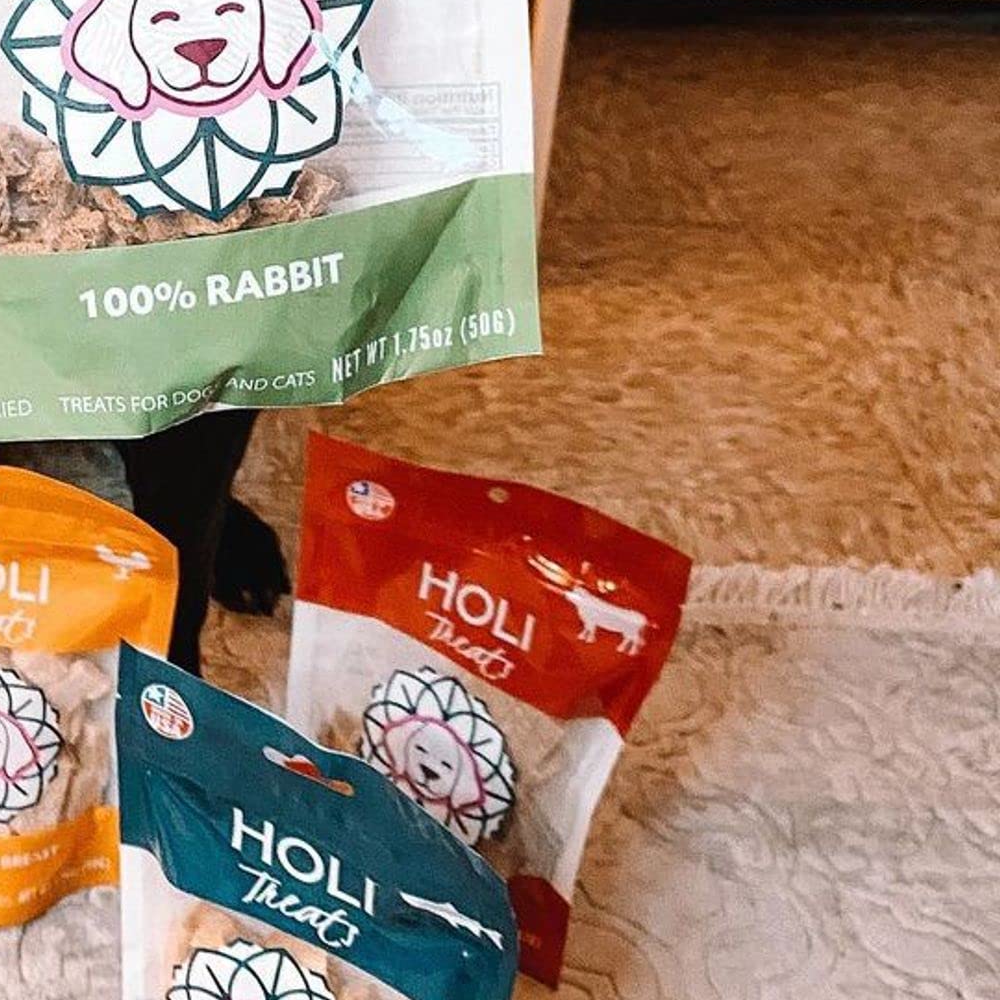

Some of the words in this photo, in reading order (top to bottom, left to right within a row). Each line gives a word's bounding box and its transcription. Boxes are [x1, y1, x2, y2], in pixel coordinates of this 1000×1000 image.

[79, 280, 197, 318] 100%
[206, 252, 344, 307] RABBIT
[332, 349, 361, 383] NET
[366, 337, 387, 366] WT
[460, 308, 516, 345] (50G)
[58, 395, 126, 414] TREATS
[130, 395, 168, 412] FOR
[172, 385, 217, 406] DOG
[225, 377, 268, 391] AND
[272, 370, 316, 390] CATS
[419, 562, 536, 652] HOLI
[424, 610, 515, 680] Treats
[231, 807, 376, 917] HOLI
[238, 863, 361, 948] Treats
